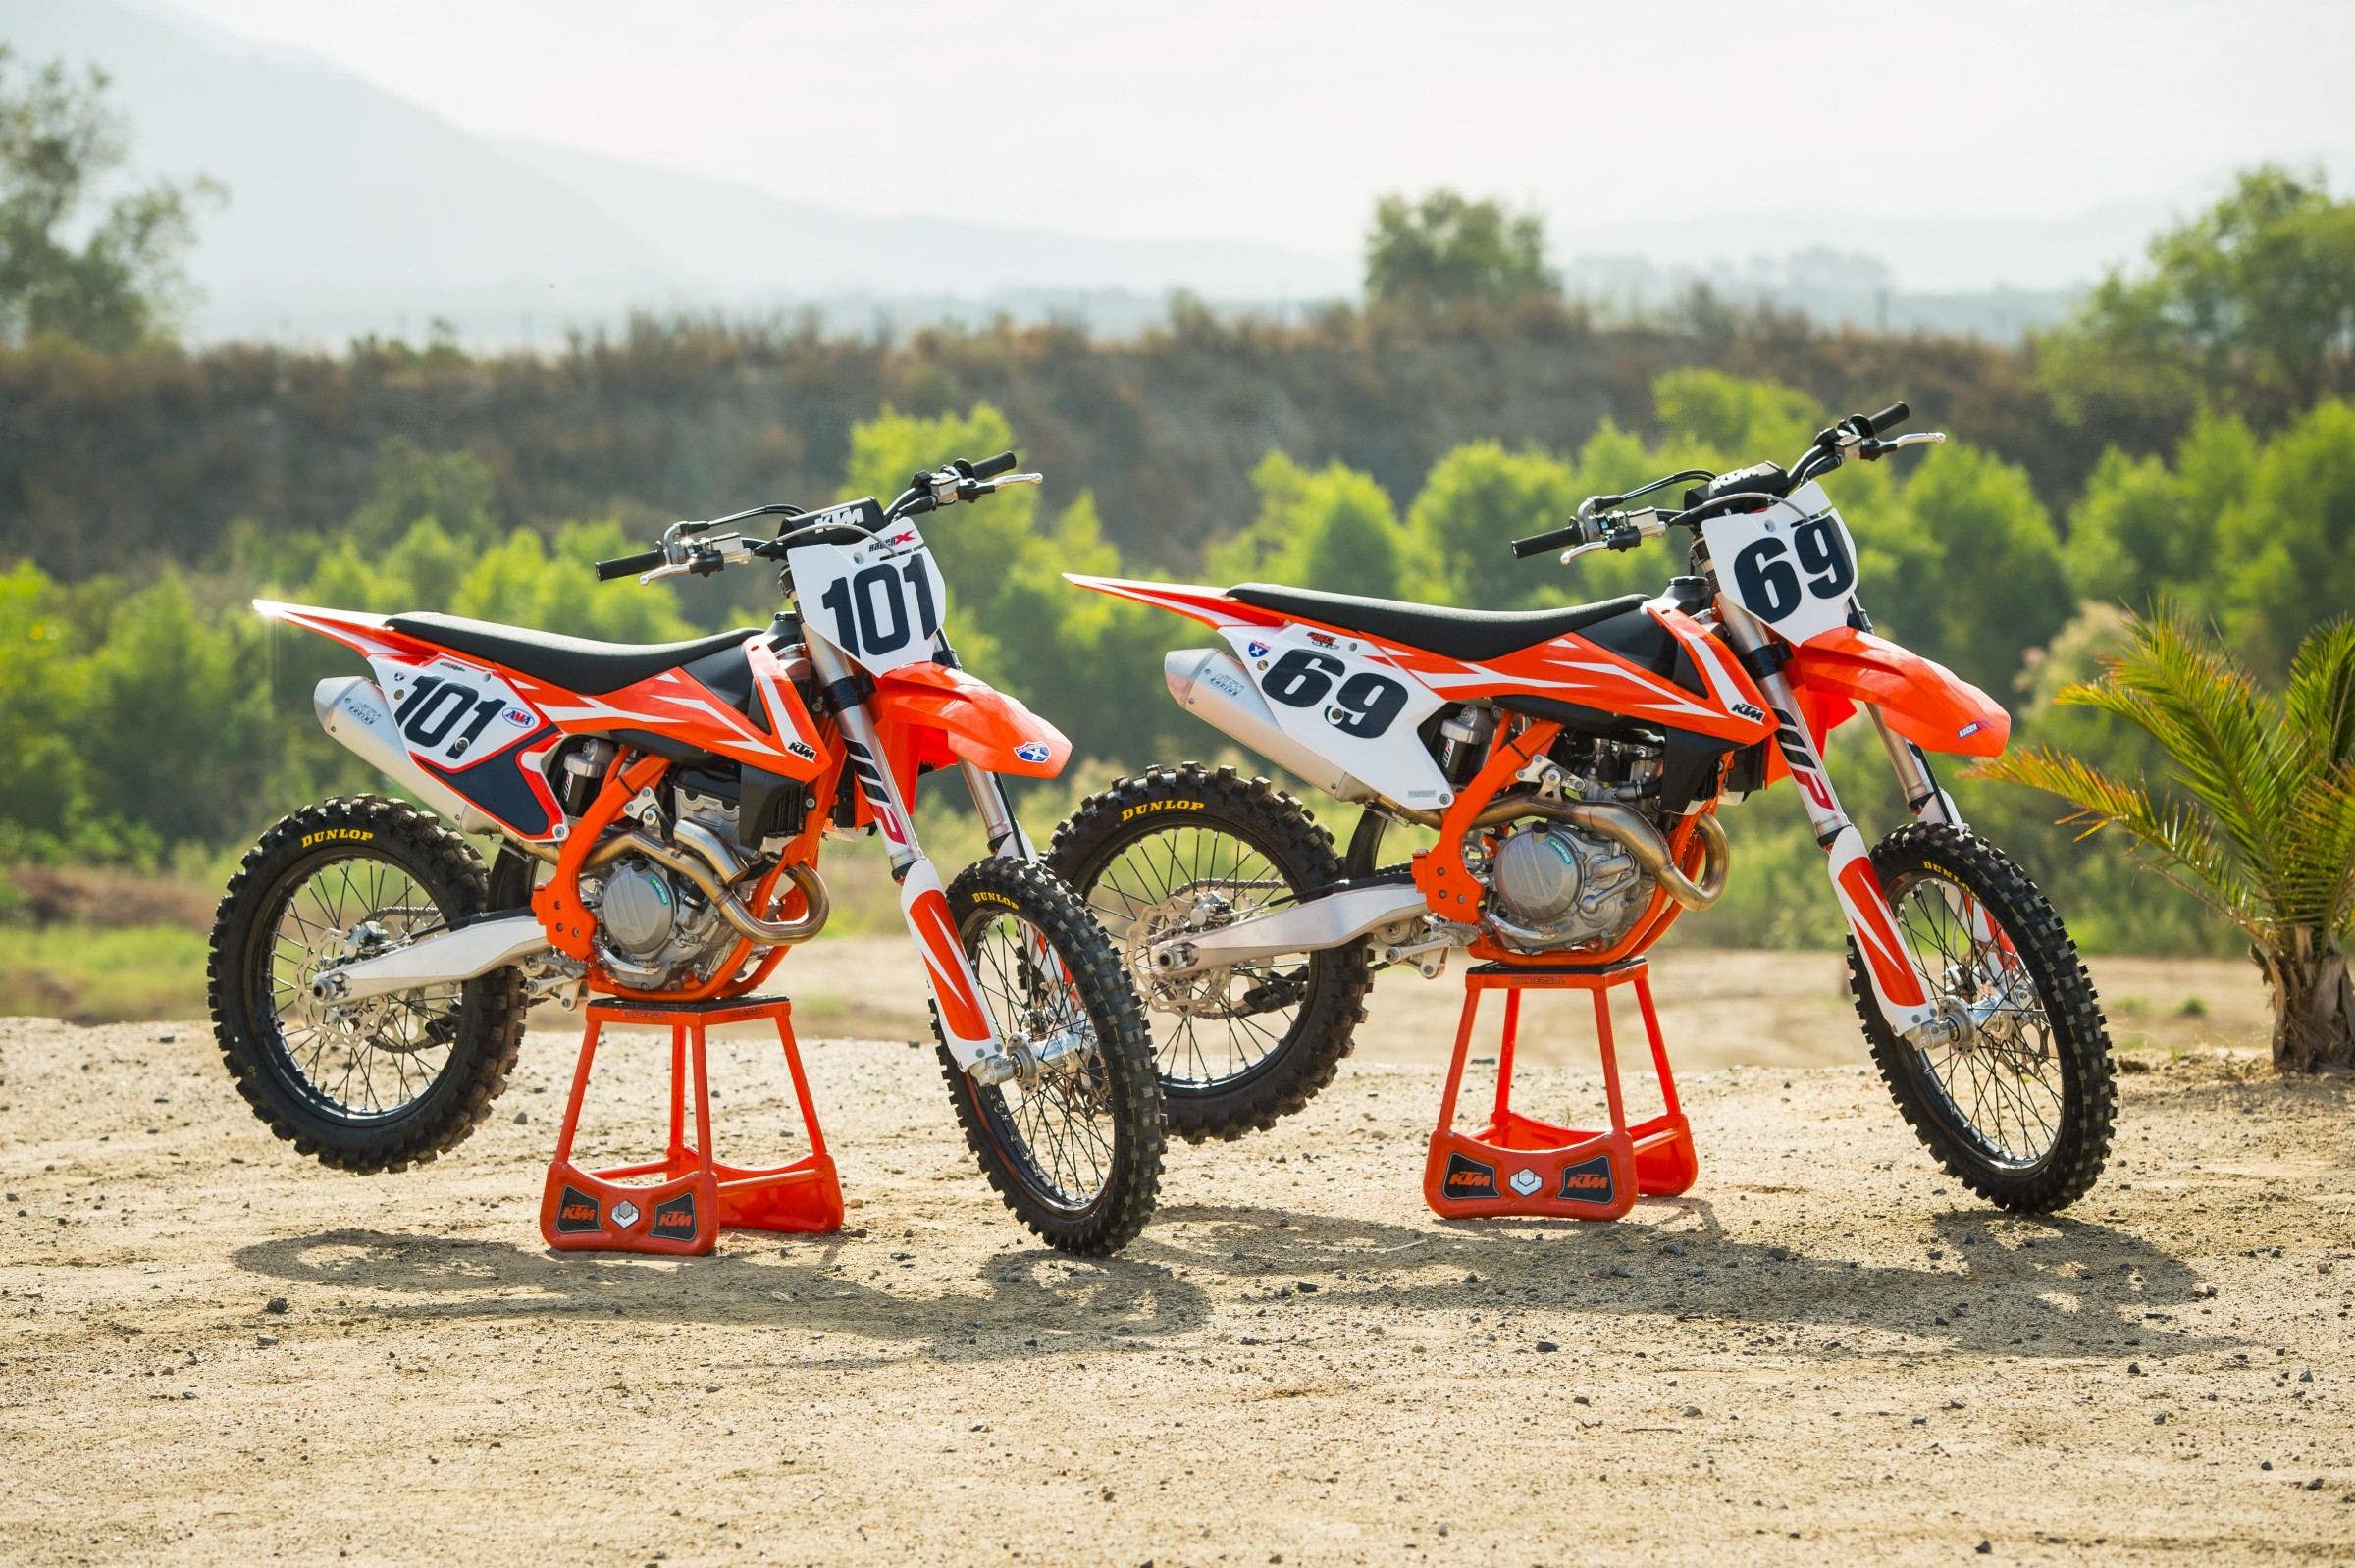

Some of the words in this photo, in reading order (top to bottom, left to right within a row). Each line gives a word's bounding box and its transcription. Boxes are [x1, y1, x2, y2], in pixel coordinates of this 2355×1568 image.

[814, 507, 864, 534] KTM
[1734, 515, 1855, 624] 69
[821, 553, 937, 659] 101
[1262, 649, 1408, 739] 69
[394, 675, 507, 759] 101
[504, 710, 531, 725] AMA
[1731, 703, 1764, 721] KTM
[788, 741, 815, 760] KTM
[1121, 800, 1205, 821] DUNLOP
[301, 828, 374, 848] DUNLOP
[1922, 860, 1981, 902] DUNLOP
[972, 892, 1020, 910] DUNLOP
[1448, 1171, 1492, 1187] KTM
[1567, 1174, 1608, 1189] KTM
[561, 1204, 597, 1221] KTM
[658, 1211, 693, 1227] KTM
